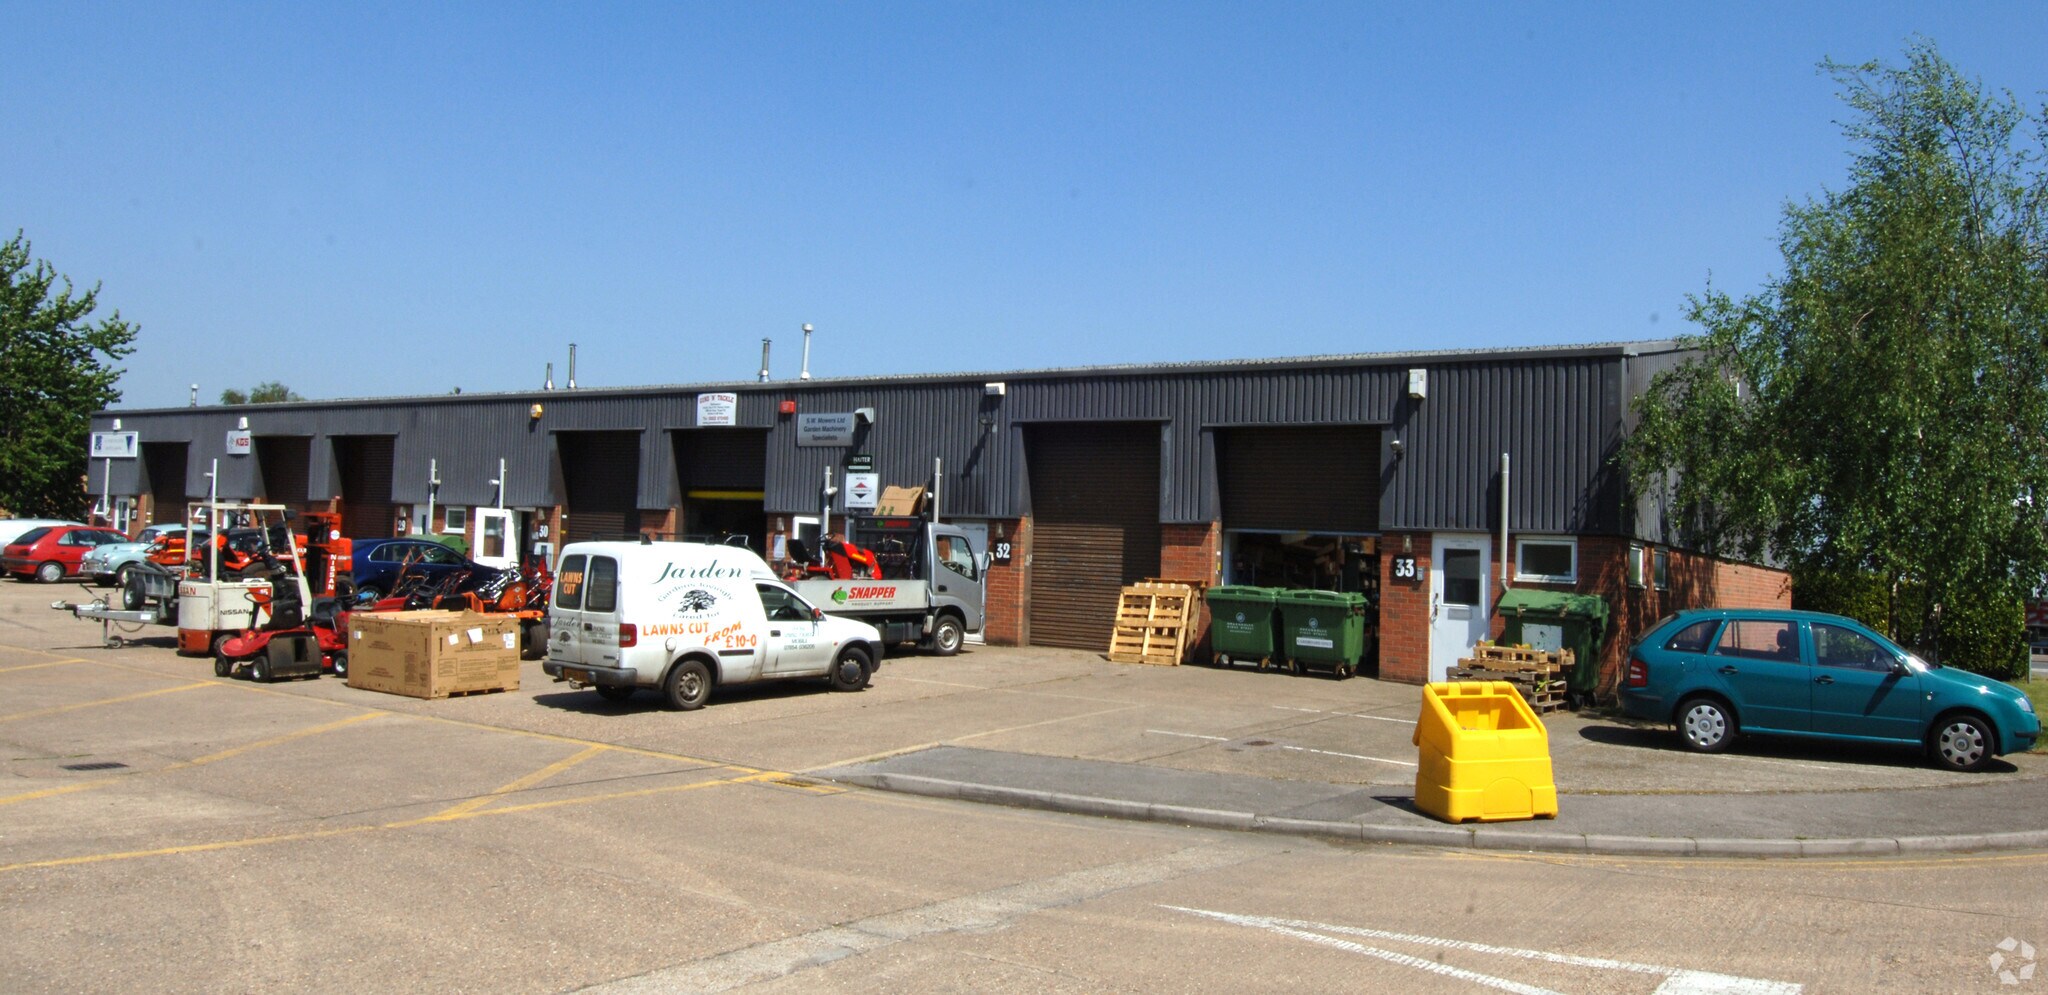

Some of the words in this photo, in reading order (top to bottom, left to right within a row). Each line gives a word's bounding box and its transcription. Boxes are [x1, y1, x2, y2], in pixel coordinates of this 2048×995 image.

[822, 425, 847, 433] Machinery
[539, 524, 549, 538] 30
[996, 543, 1011, 559] 32
[327, 554, 337, 590] NISSAN
[650, 559, 742, 585] Jarden
[1395, 559, 1415, 577] 33
[560, 571, 583, 584] LAWNS
[563, 583, 577, 595] CUT
[848, 586, 897, 599] SNAPPER
[219, 608, 249, 616] NISSAN
[642, 623, 684, 637] LAWNS
[688, 622, 709, 634] CUT
[703, 621, 742, 647] FROM
[725, 634, 757, 648] £10-0
